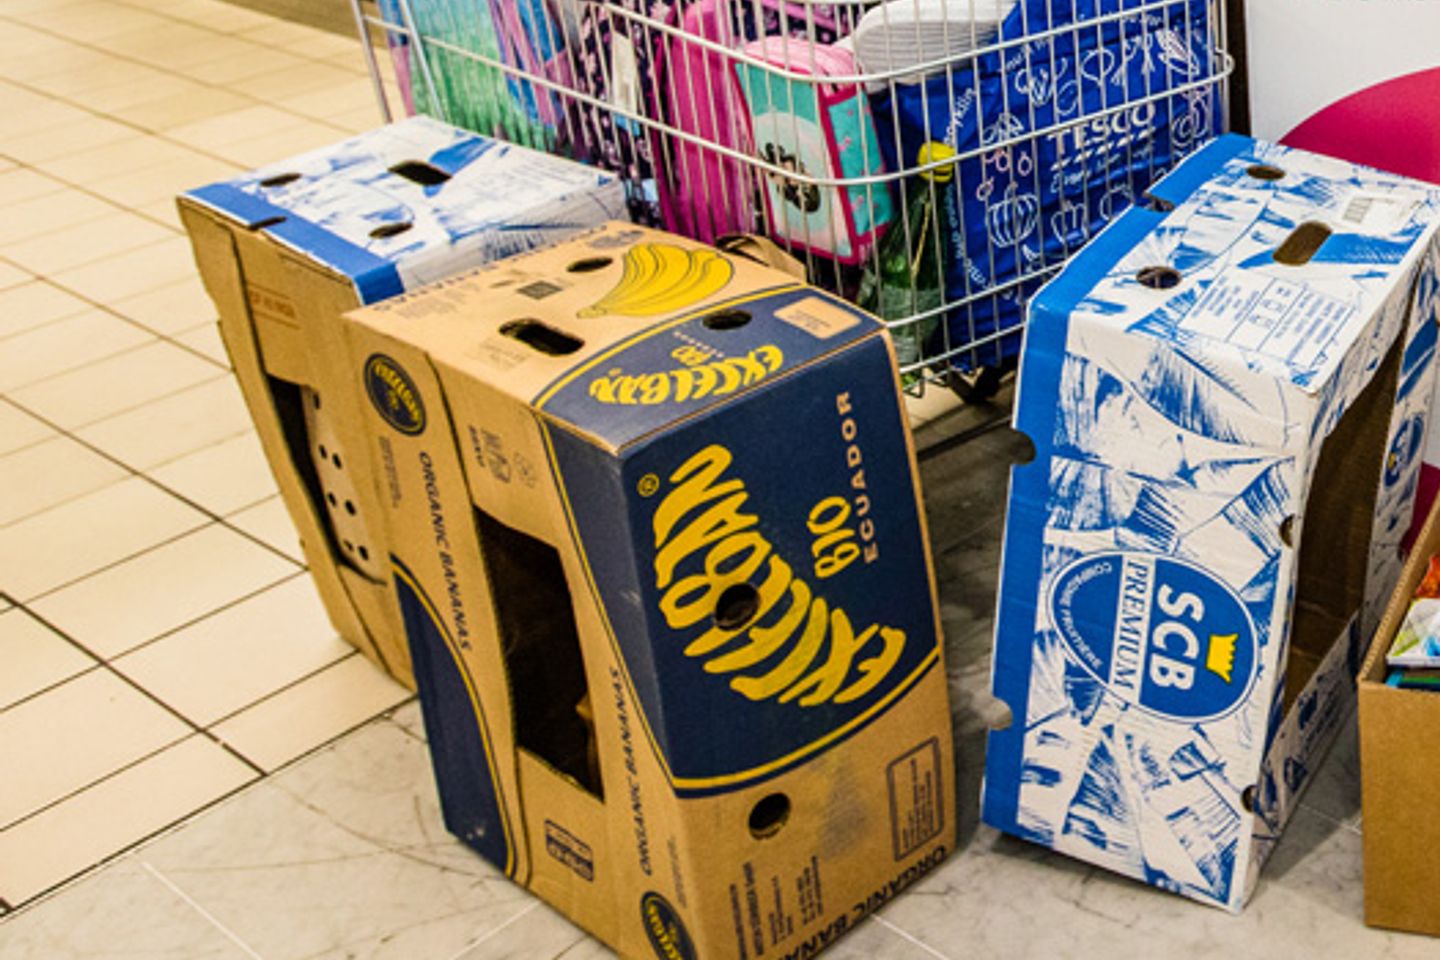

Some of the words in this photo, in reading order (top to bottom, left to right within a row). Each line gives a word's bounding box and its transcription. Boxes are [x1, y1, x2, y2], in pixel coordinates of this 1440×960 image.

[1048, 102, 1156, 155] TESCO
[589, 344, 784, 405] EXCELBAN
[419, 451, 450, 545] ORGANIC
[836, 391, 880, 564] ECUADOR
[653, 444, 906, 707] EXCELBAN
[806, 496, 861, 579] BIO
[1113, 561, 1149, 690] PREMIUM
[1149, 583, 1206, 691] SCB
